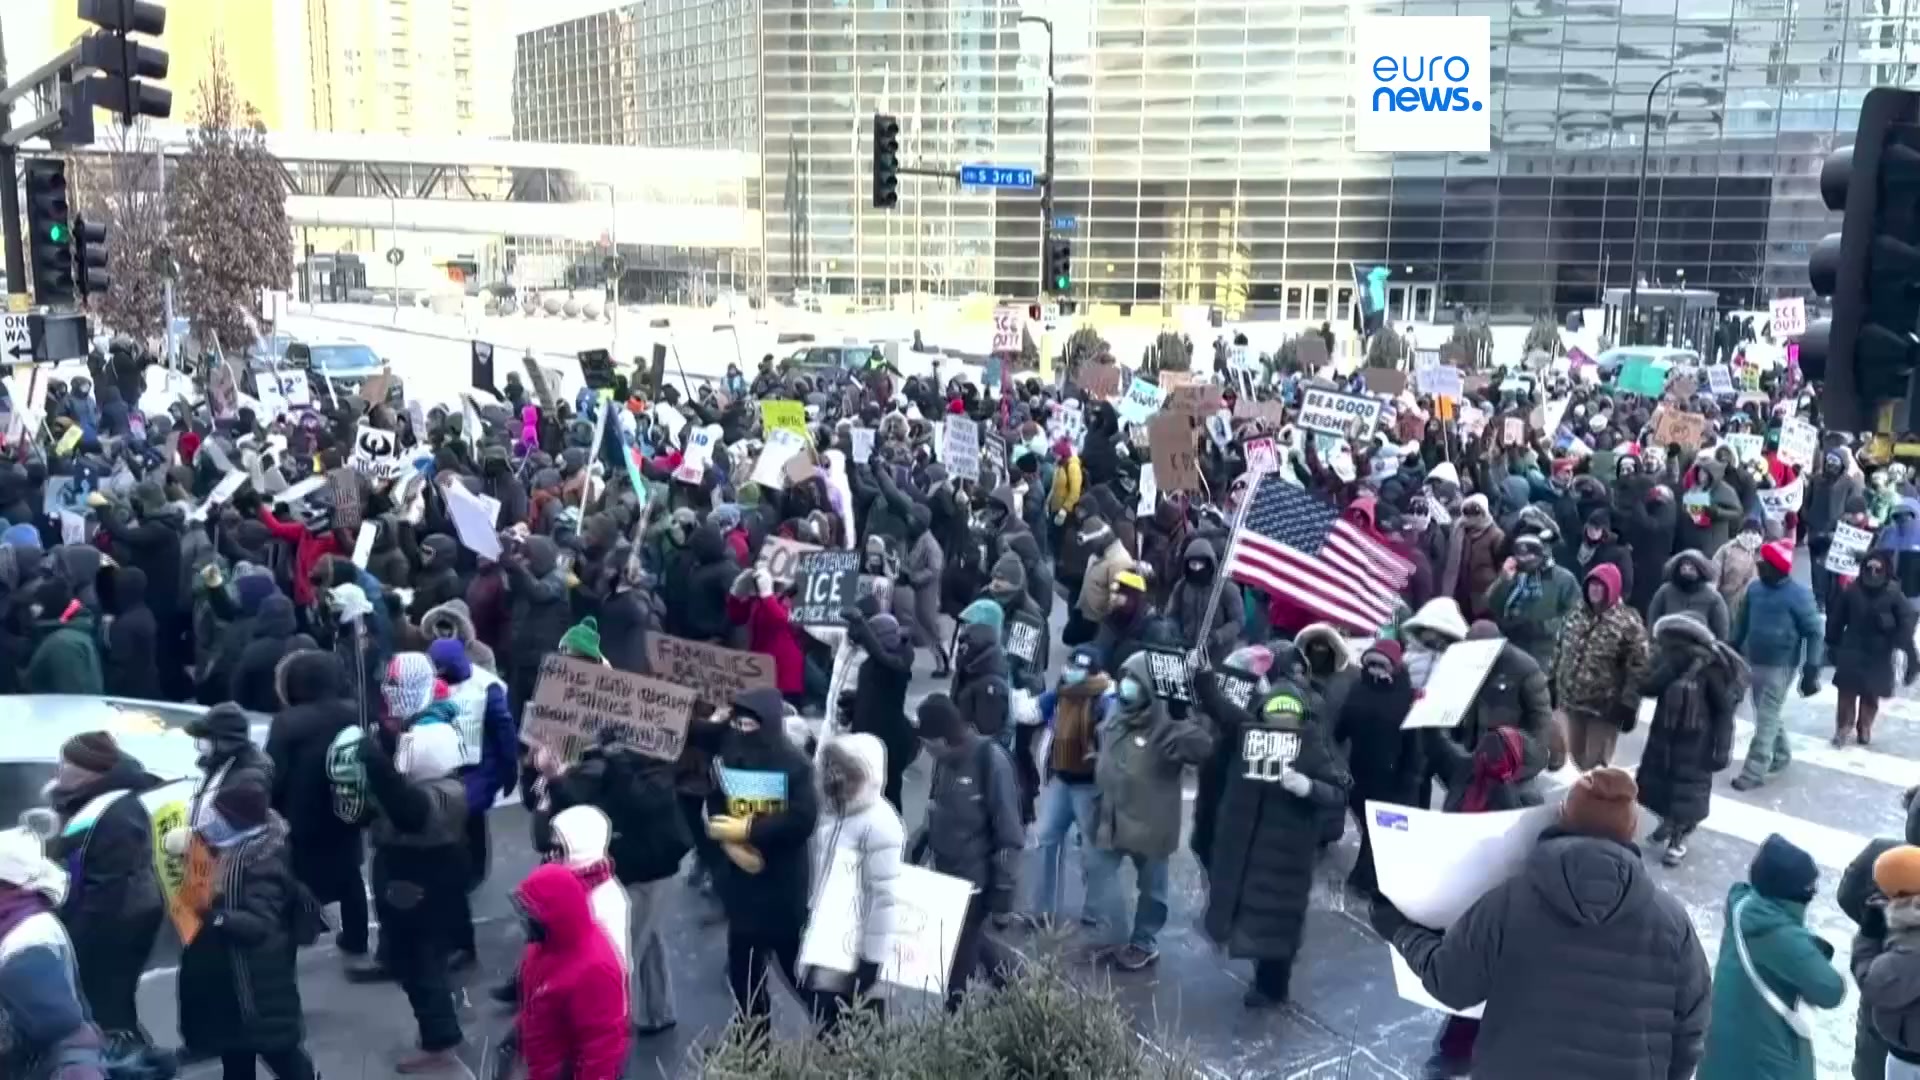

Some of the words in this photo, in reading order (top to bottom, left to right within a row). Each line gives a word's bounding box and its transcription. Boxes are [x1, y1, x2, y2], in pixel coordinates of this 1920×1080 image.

[978, 170, 987, 182] S
[992, 172, 1013, 184] 3rd
[1017, 172, 1031, 185] St
[1776, 306, 1797, 318] ICE
[1307, 393, 1324, 408] BE
[1325, 397, 1333, 408] A
[1336, 399, 1374, 417] GOOD
[804, 571, 845, 603] ICE
[657, 639, 763, 678] FAMILIES
